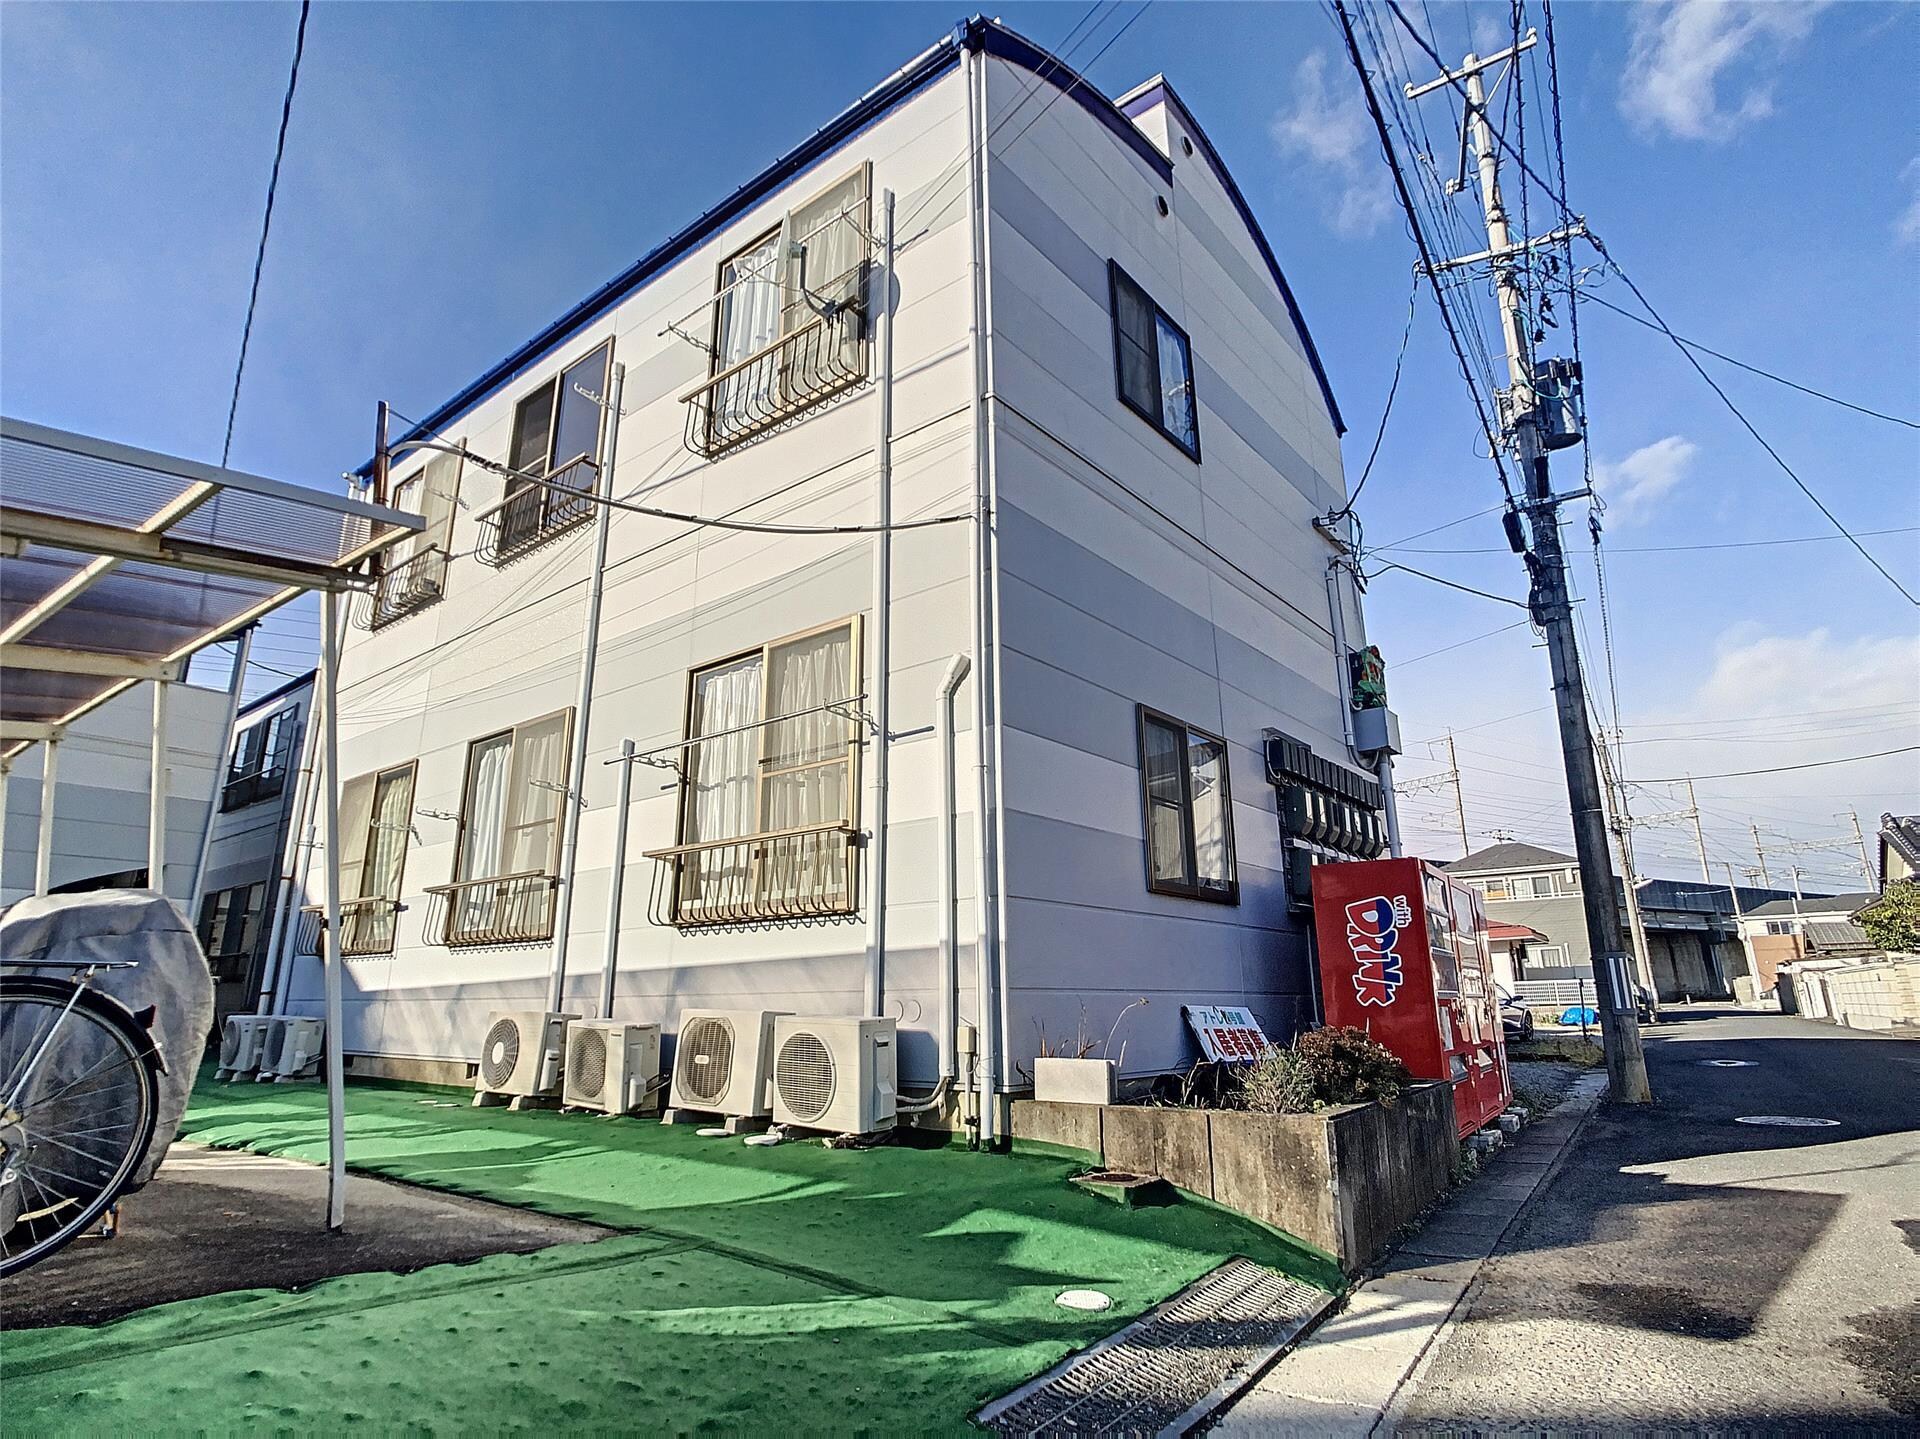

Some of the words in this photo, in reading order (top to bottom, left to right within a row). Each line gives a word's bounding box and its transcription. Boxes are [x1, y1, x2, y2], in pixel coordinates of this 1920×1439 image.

[1394, 896, 1411, 927] with
[1345, 896, 1403, 1006] DRINK
[1199, 1011, 1245, 1025] アトレ号館
[1203, 1028, 1265, 1058] 入居者募集
